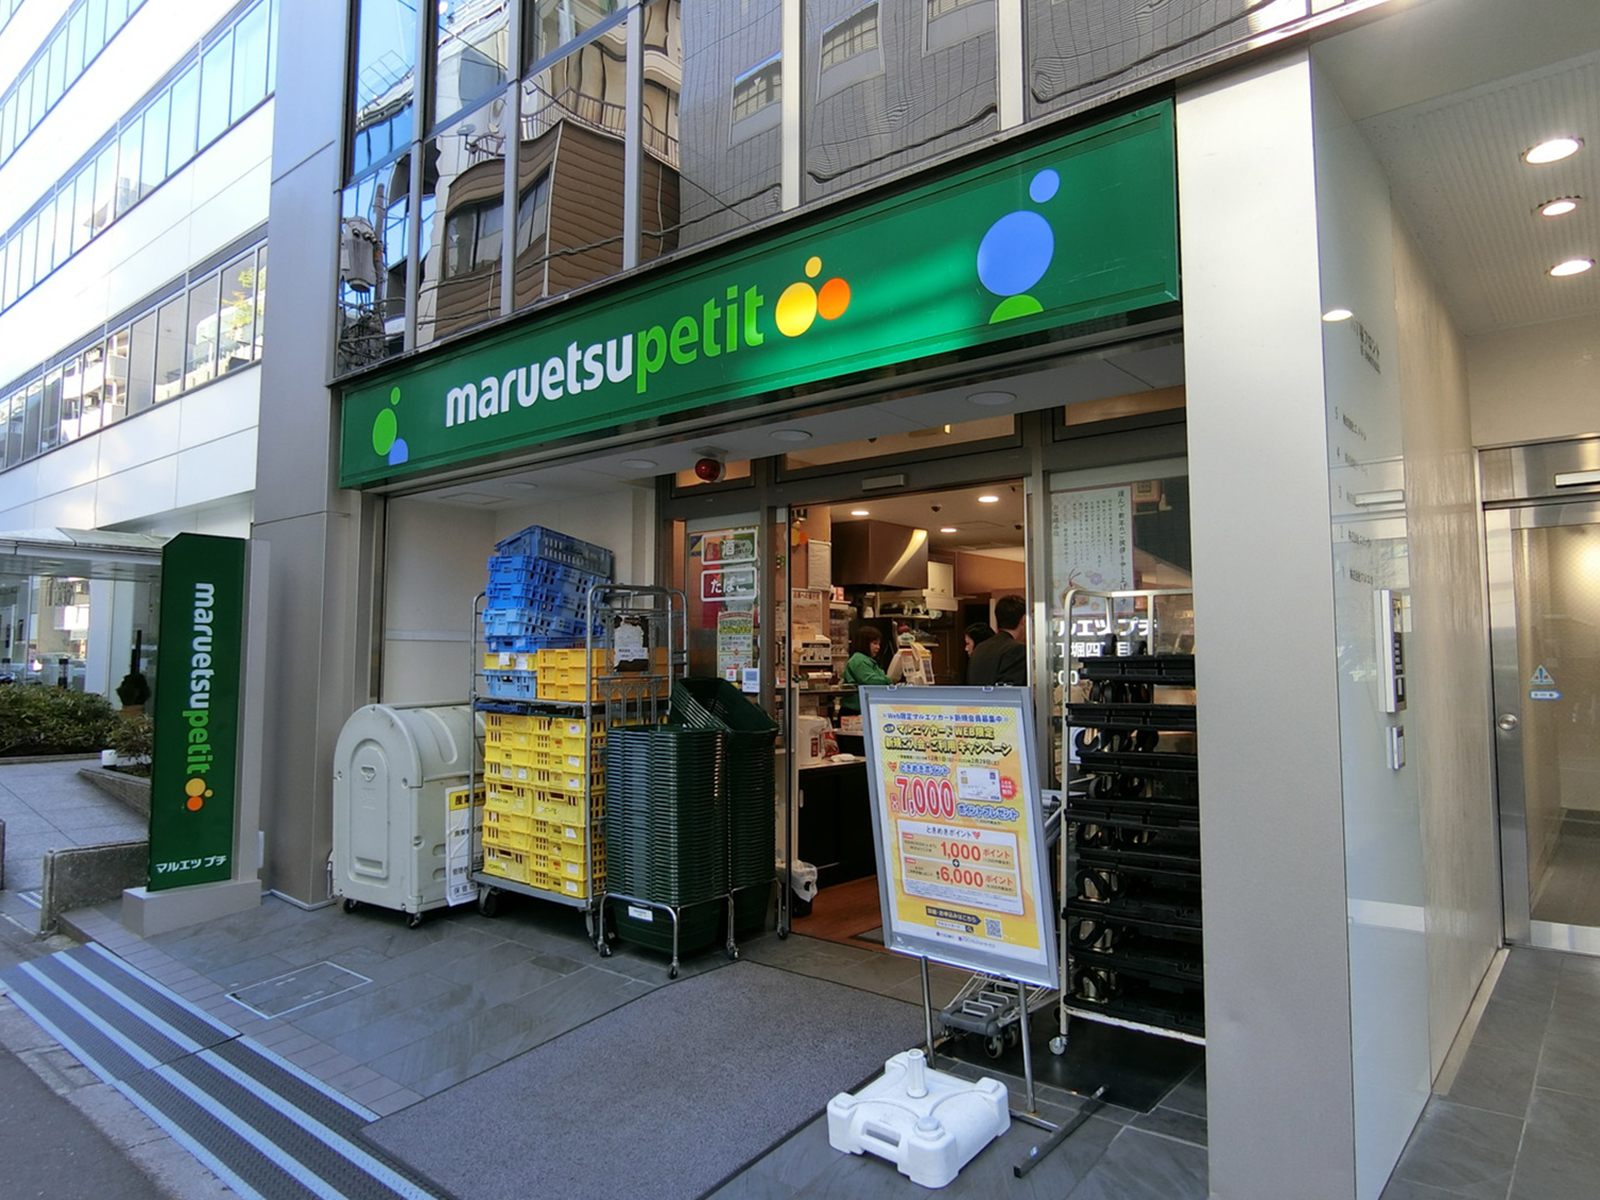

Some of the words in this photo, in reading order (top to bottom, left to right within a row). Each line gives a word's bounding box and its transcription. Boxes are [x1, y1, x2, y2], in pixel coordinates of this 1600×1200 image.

[711, 578, 747, 594] たばこ
[1055, 618, 1113, 636] ルエツ
[1055, 641, 1131, 657] 丁堀四目
[897, 724, 953, 738] マルエツカード
[955, 726, 995, 739] WEB限定
[957, 740, 1013, 757] キャンペーン
[895, 776, 956, 820] 7,000
[926, 825, 972, 839] ときめきポイント
[940, 841, 981, 862] 1,000
[982, 847, 1011, 859] ポイント
[155, 857, 202, 874] マルエツ
[203, 854, 227, 868] プチ
[940, 866, 983, 888] 6,000
[985, 874, 1014, 886] ポイント
